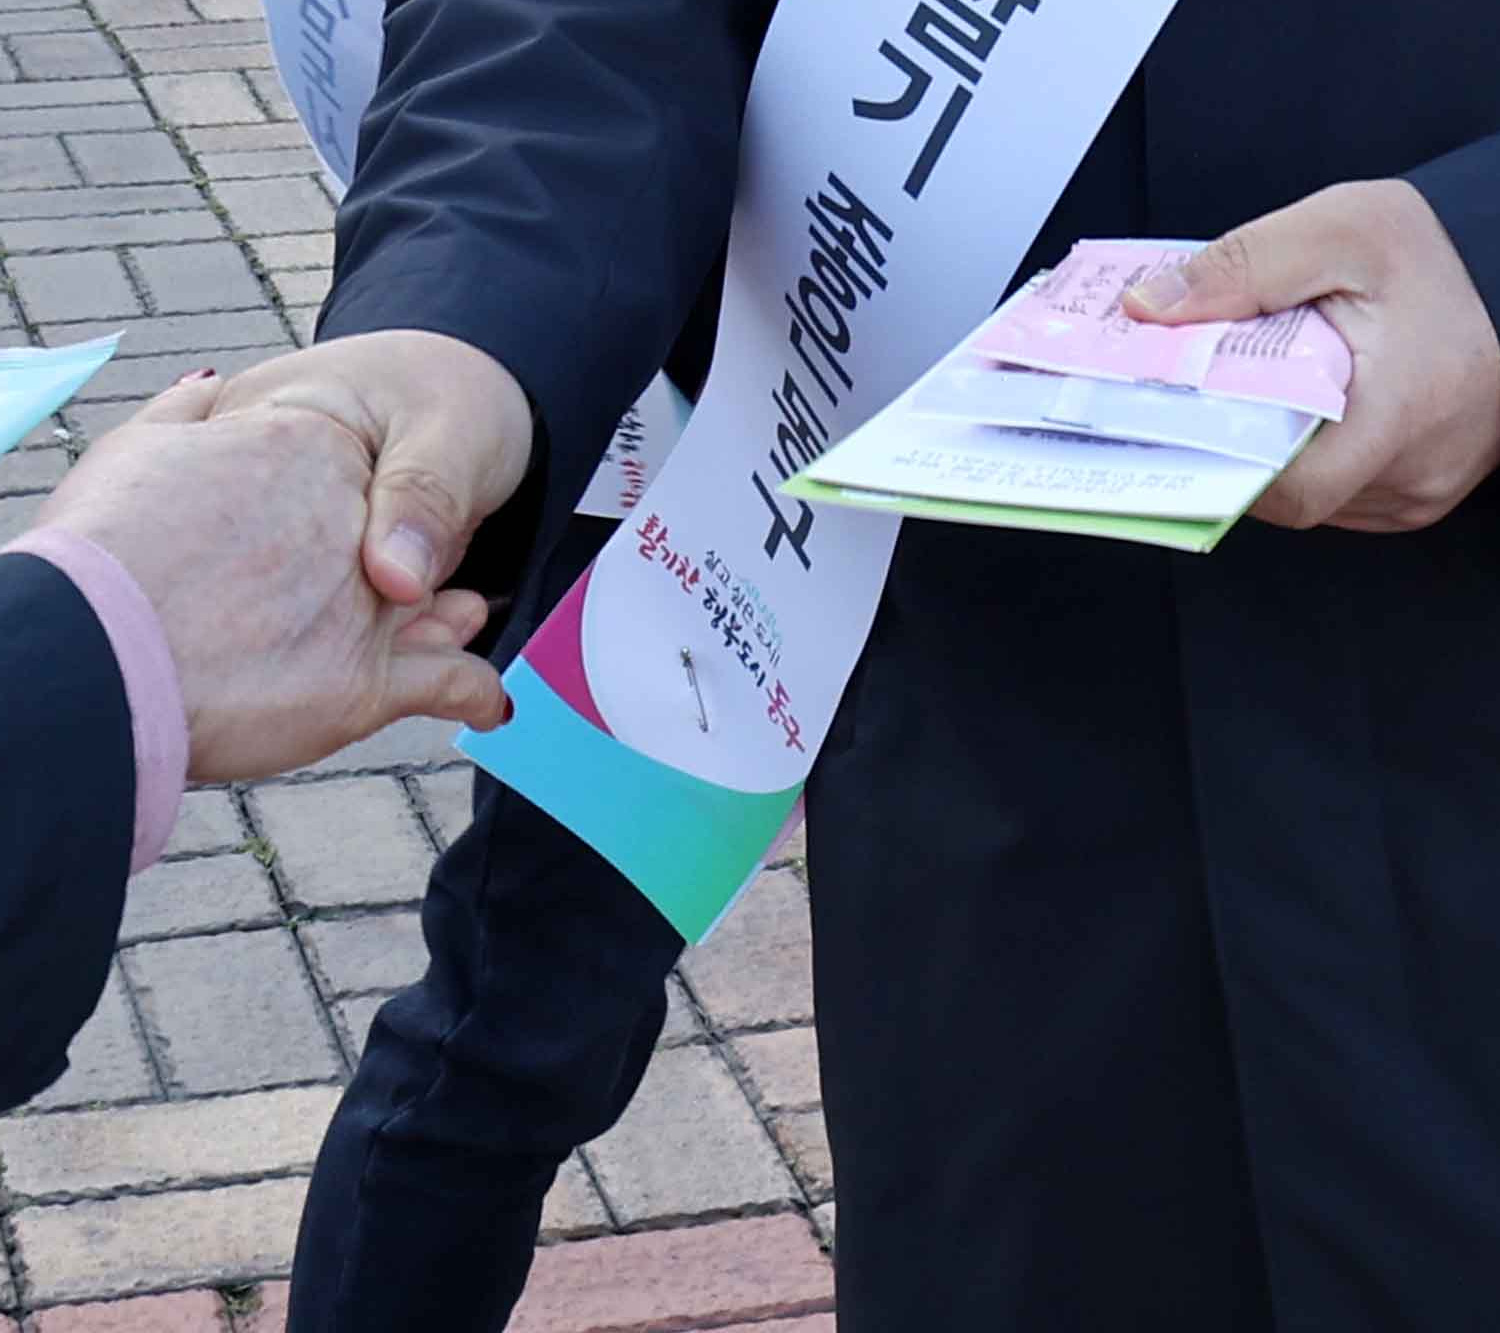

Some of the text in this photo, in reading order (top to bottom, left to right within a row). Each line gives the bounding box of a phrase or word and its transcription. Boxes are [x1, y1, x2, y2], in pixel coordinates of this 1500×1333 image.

[785, 171, 895, 410] 좋은
[636, 513, 701, 594] 활기찬
[766, 679, 805, 753] 동구
